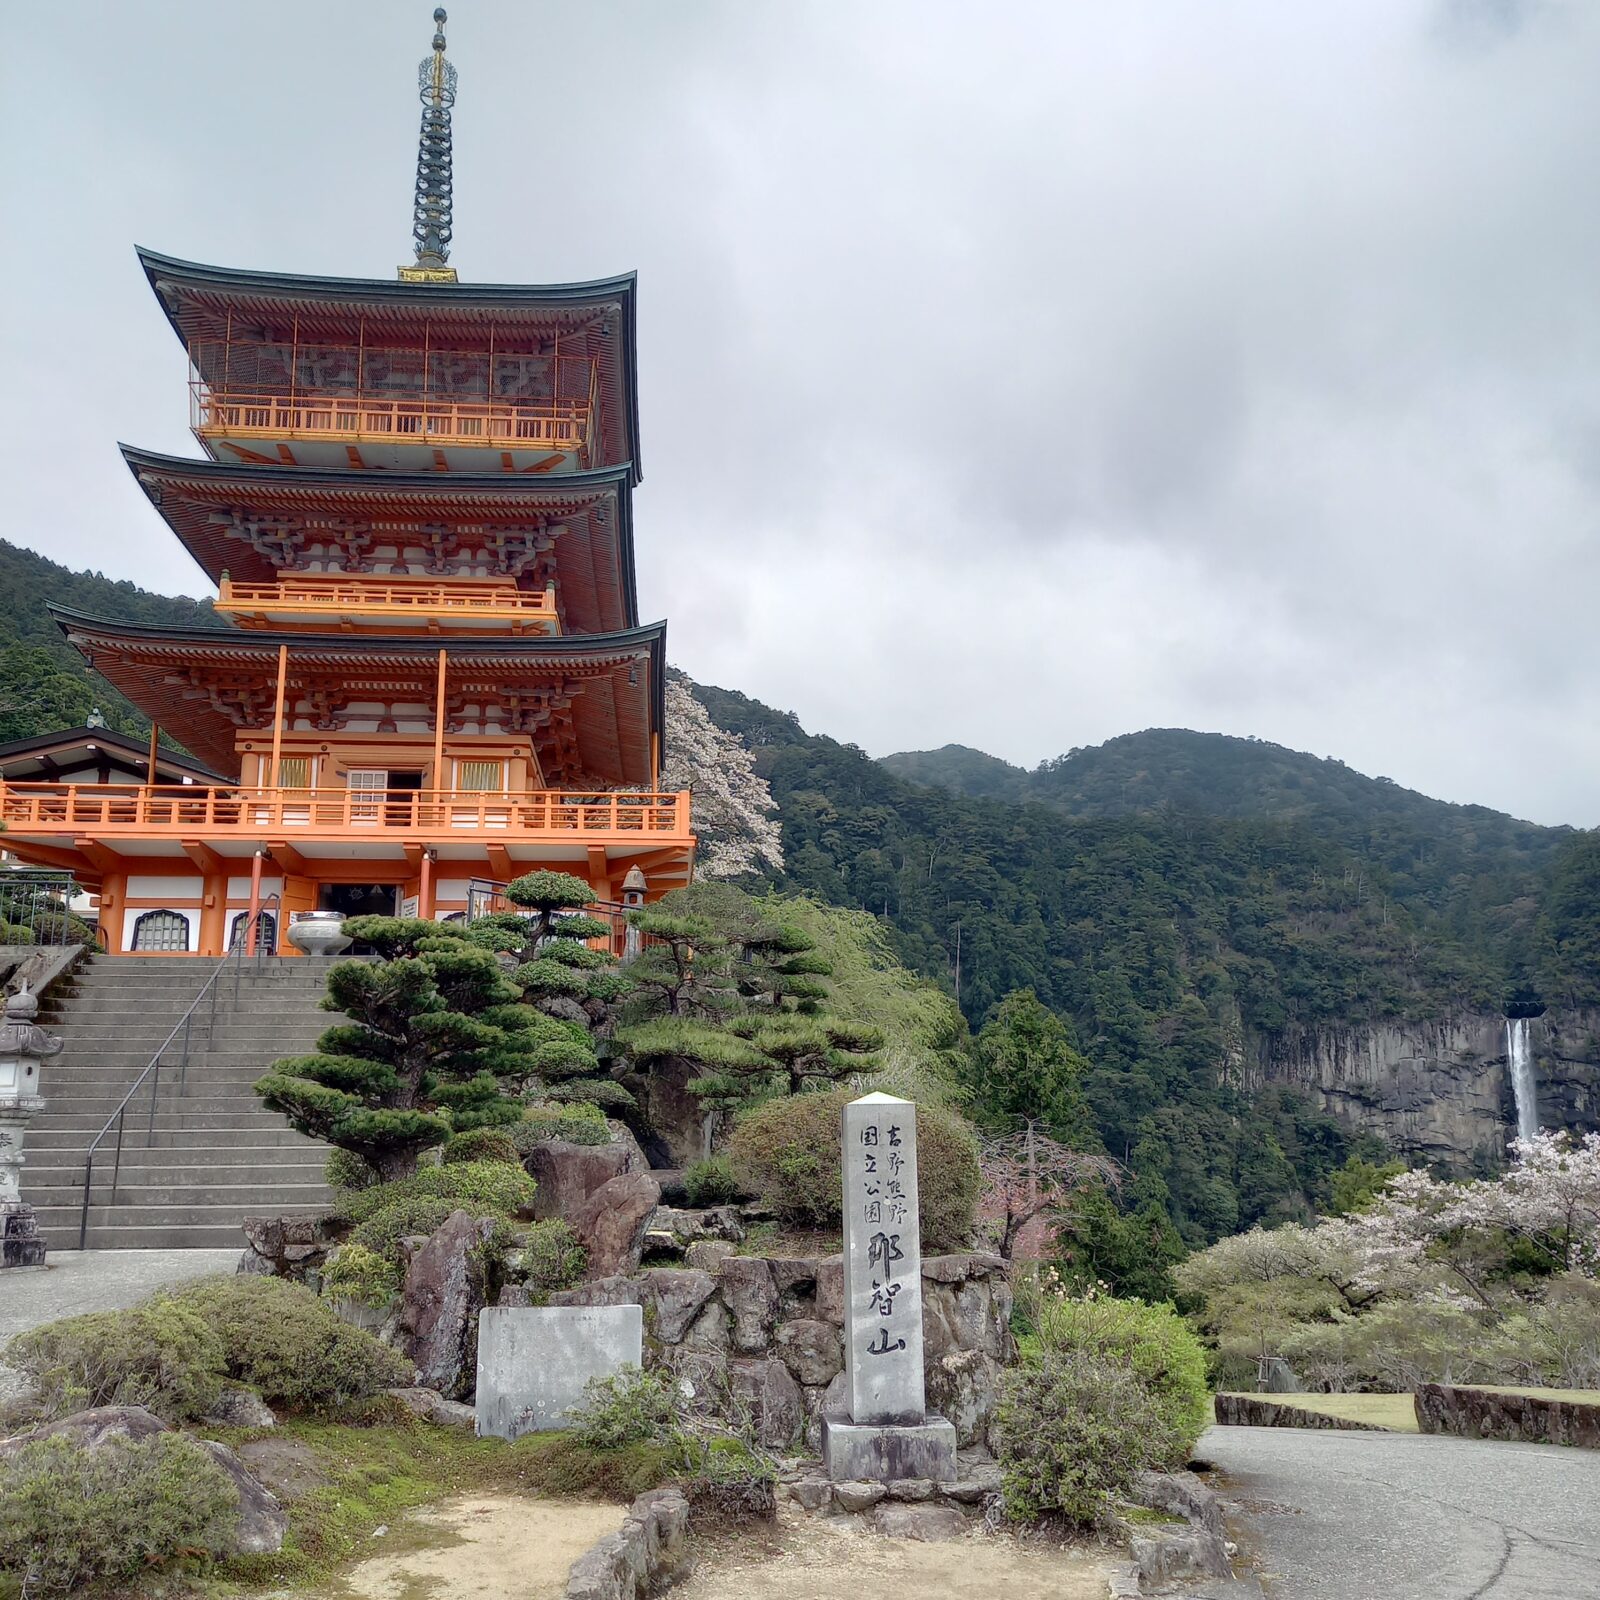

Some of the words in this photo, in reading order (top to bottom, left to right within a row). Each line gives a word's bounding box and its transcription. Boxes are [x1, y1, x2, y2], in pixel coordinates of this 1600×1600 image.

[861, 1126, 881, 1223] 国立公園
[884, 1125, 907, 1224] 吉野熊野
[867, 1232, 906, 1356] 那智山
